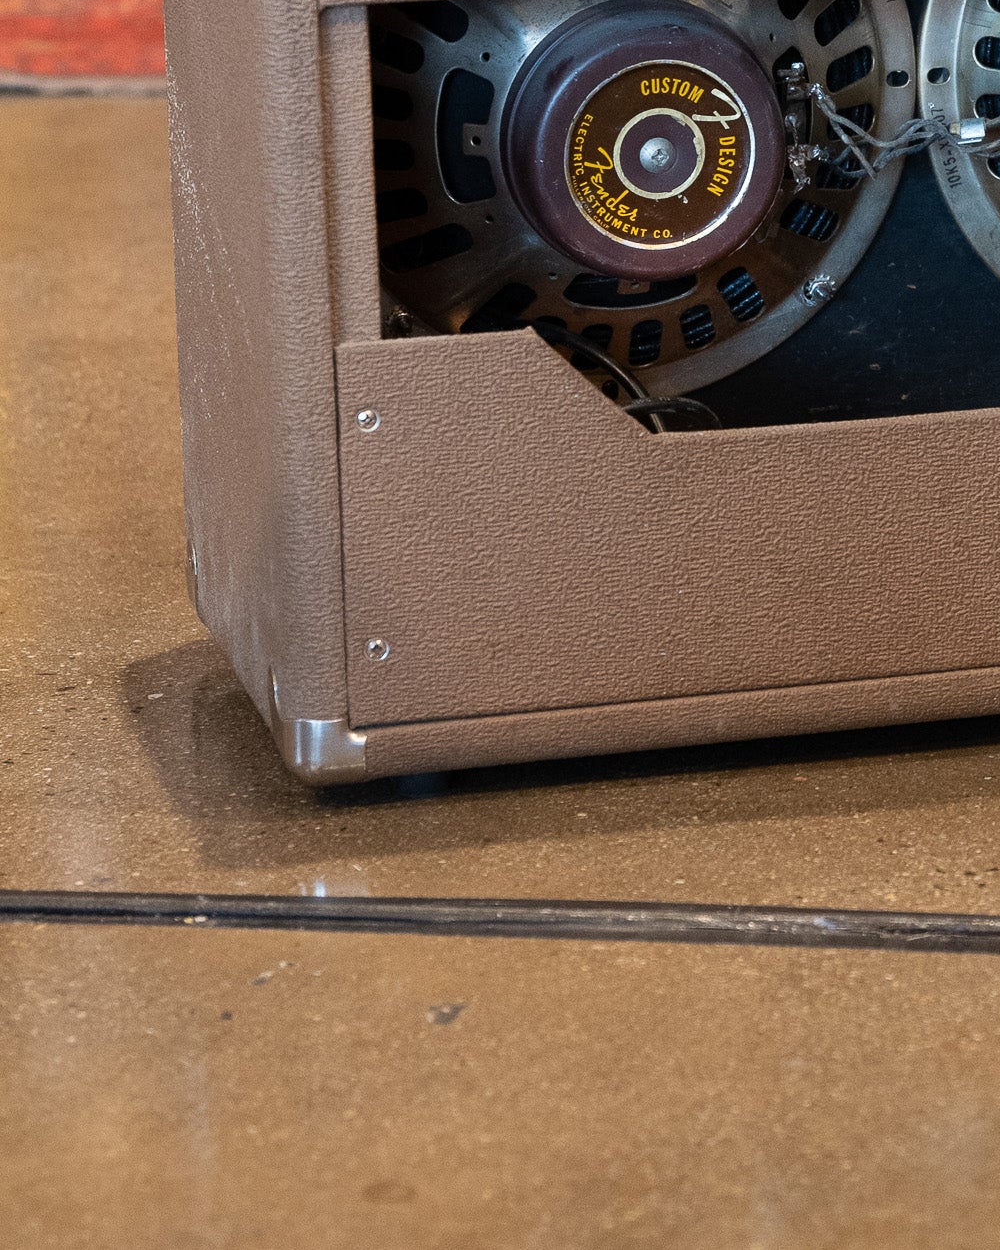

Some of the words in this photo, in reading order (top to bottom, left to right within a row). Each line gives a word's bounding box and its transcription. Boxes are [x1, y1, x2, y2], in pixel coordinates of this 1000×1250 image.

[572, 113, 594, 176] ELECTRIC
[640, 76, 705, 104] CUSTOM
[706, 135, 736, 197] DESIGN
[930, 108, 963, 189] 10K5-X07
[579, 181, 648, 239] INSTRUMENT
[583, 146, 639, 222] Fender
[652, 228, 673, 239] CO.
